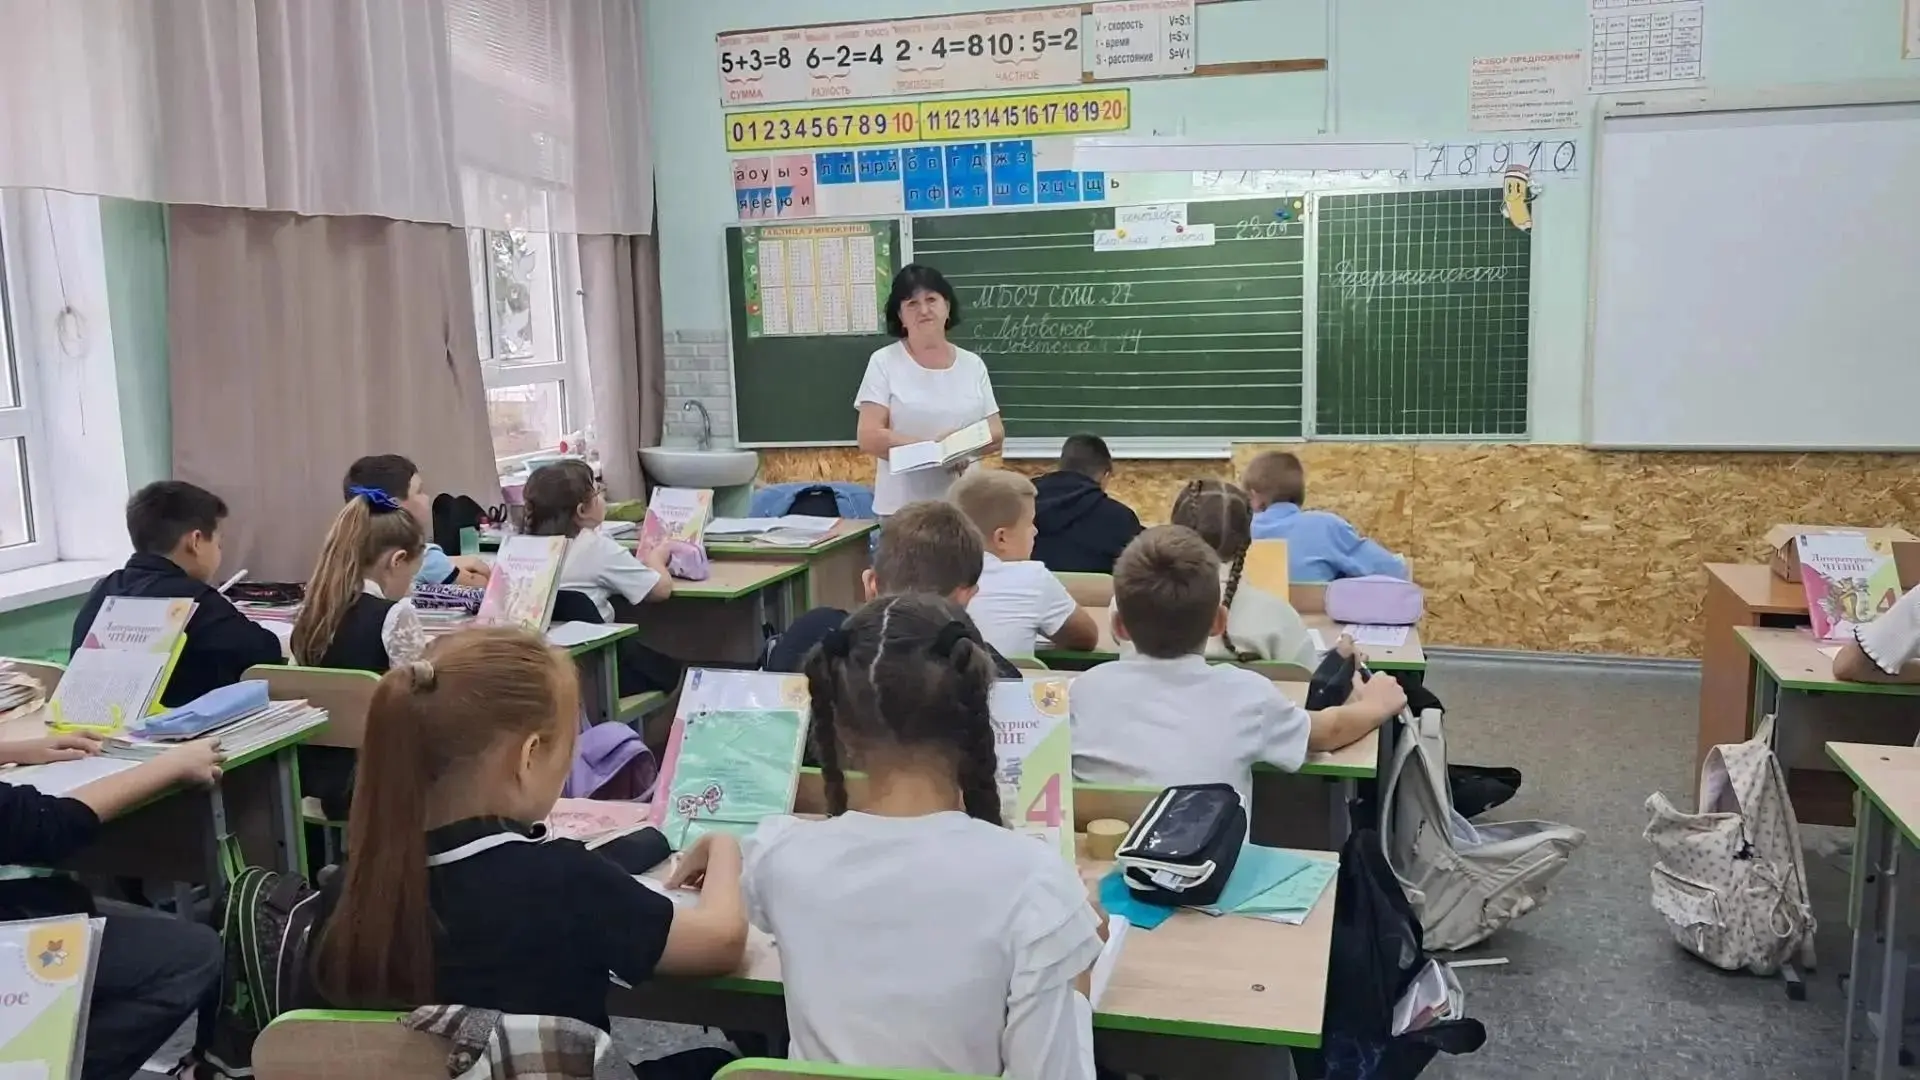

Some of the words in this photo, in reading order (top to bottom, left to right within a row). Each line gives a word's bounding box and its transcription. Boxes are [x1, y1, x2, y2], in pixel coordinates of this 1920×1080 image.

[1108, 20, 1144, 33] скорость
[1106, 38, 1130, 50] время
[721, 47, 791, 73] 5+3=8
[1108, 53, 1154, 67] расстояние
[995, 71, 1040, 81] ЧАСТНОЕ
[730, 89, 764, 100] СУММА
[811, 86, 851, 97] РАЗНОСТЬ
[927, 110, 940, 130] 11
[945, 109, 960, 129] 12
[964, 108, 980, 129] 13
[983, 107, 1000, 128] 14
[1003, 106, 1019, 126] 15
[1022, 105, 1038, 125] 16
[1042, 103, 1058, 124] 17
[1063, 102, 1078, 123] 18
[1082, 101, 1099, 121] 19
[1103, 100, 1122, 120] 20
[733, 122, 743, 142] 0
[748, 121, 756, 141] 1
[764, 120, 775, 140] 2
[780, 119, 790, 139] 3
[795, 118, 807, 138] 4
[812, 117, 822, 137] 5
[827, 116, 838, 137] 6
[842, 115, 853, 136] 7
[859, 115, 870, 135] 8
[875, 114, 886, 134] 9
[893, 112, 913, 133] 10
[1458, 145, 1477, 175] 8
[972, 284, 1040, 308] МБОУ
[1049, 284, 1096, 307] СОШ
[1026, 773, 1063, 827] 4
